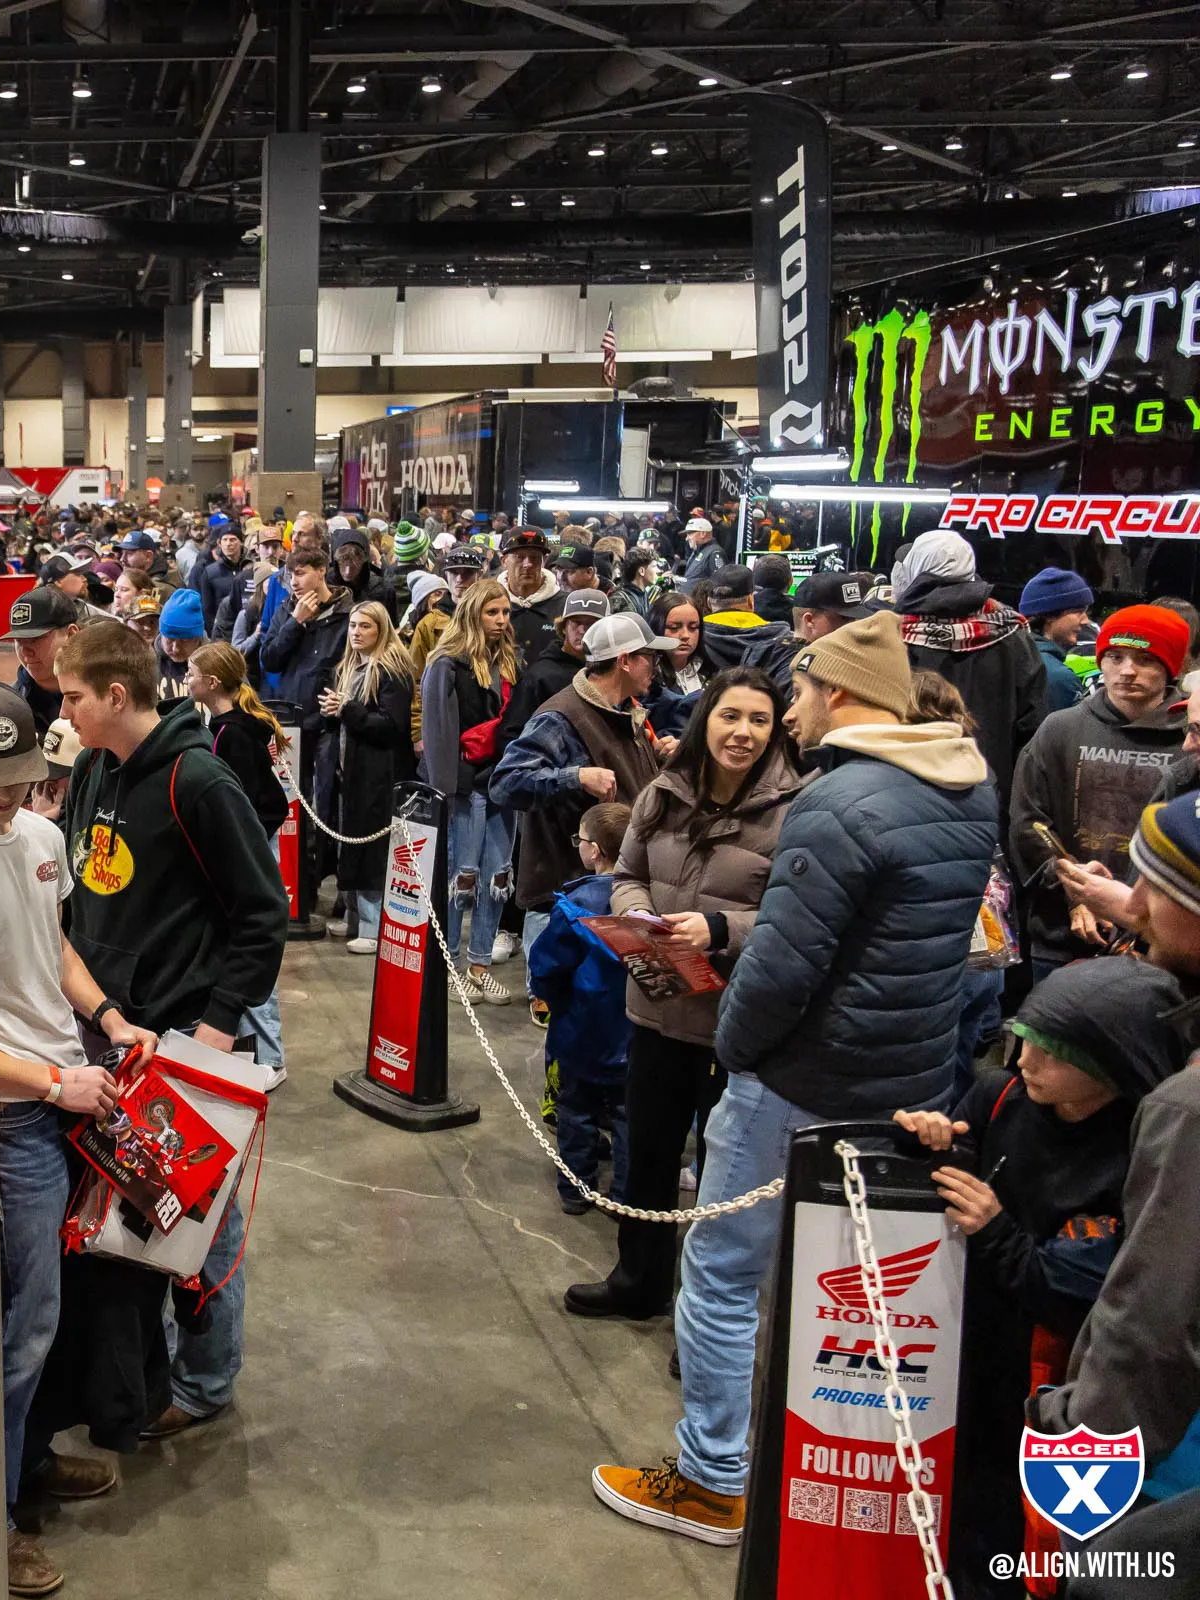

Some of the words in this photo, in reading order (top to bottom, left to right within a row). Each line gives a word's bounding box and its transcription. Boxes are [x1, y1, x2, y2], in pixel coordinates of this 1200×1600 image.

[777, 145, 809, 395] SCOTT
[975, 396, 1200, 441] ENERGY
[400, 454, 473, 496] HONDA
[939, 494, 1039, 538] PRO
[91, 862, 122, 892] Shops
[392, 864, 417, 877] HOND
[384, 923, 408, 944] FOLLOW
[409, 928, 421, 948] US
[157, 1194, 183, 1230] 29
[812, 1365, 867, 1380] Honda
[801, 1443, 897, 1484] FOLLOW
